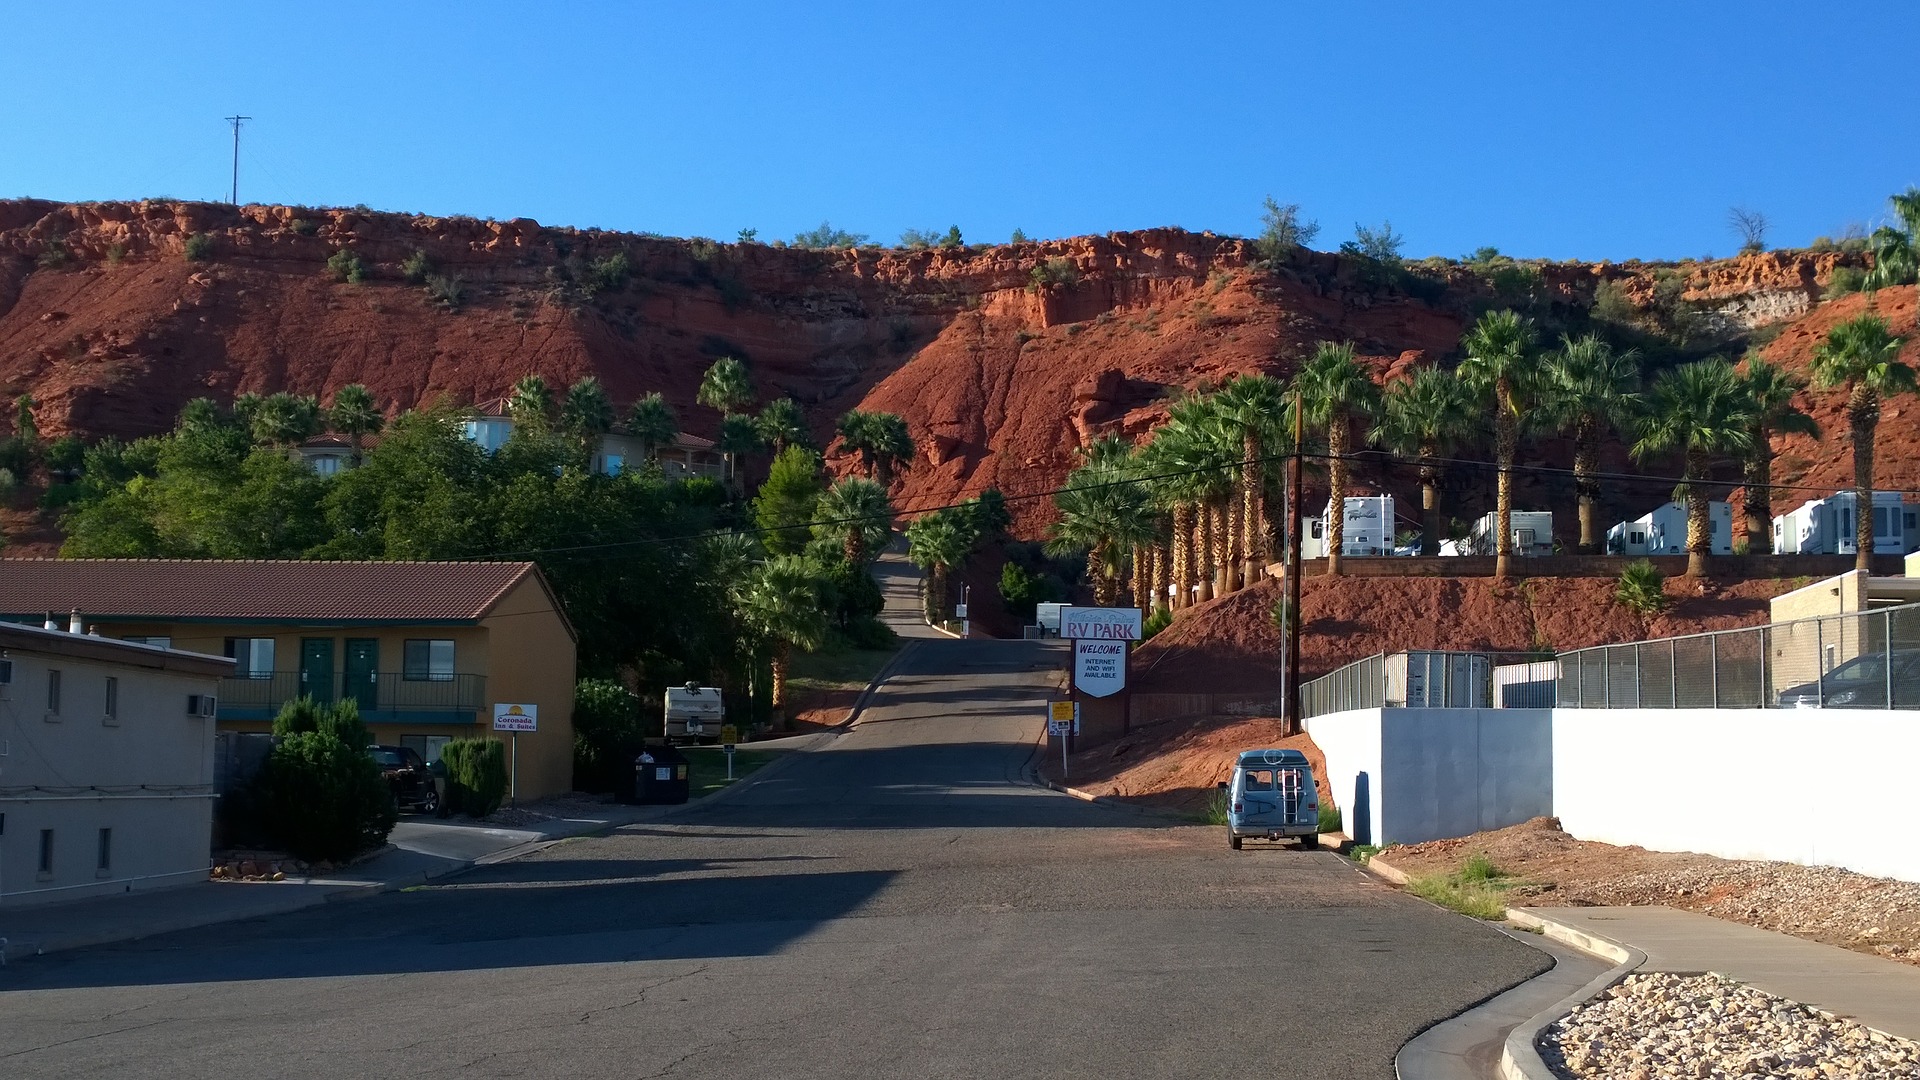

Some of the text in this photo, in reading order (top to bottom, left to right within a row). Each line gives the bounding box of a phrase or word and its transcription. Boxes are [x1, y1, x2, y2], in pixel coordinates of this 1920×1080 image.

[1067, 623, 1135, 638] RV PARK
[1080, 644, 1122, 654] WELCOME
